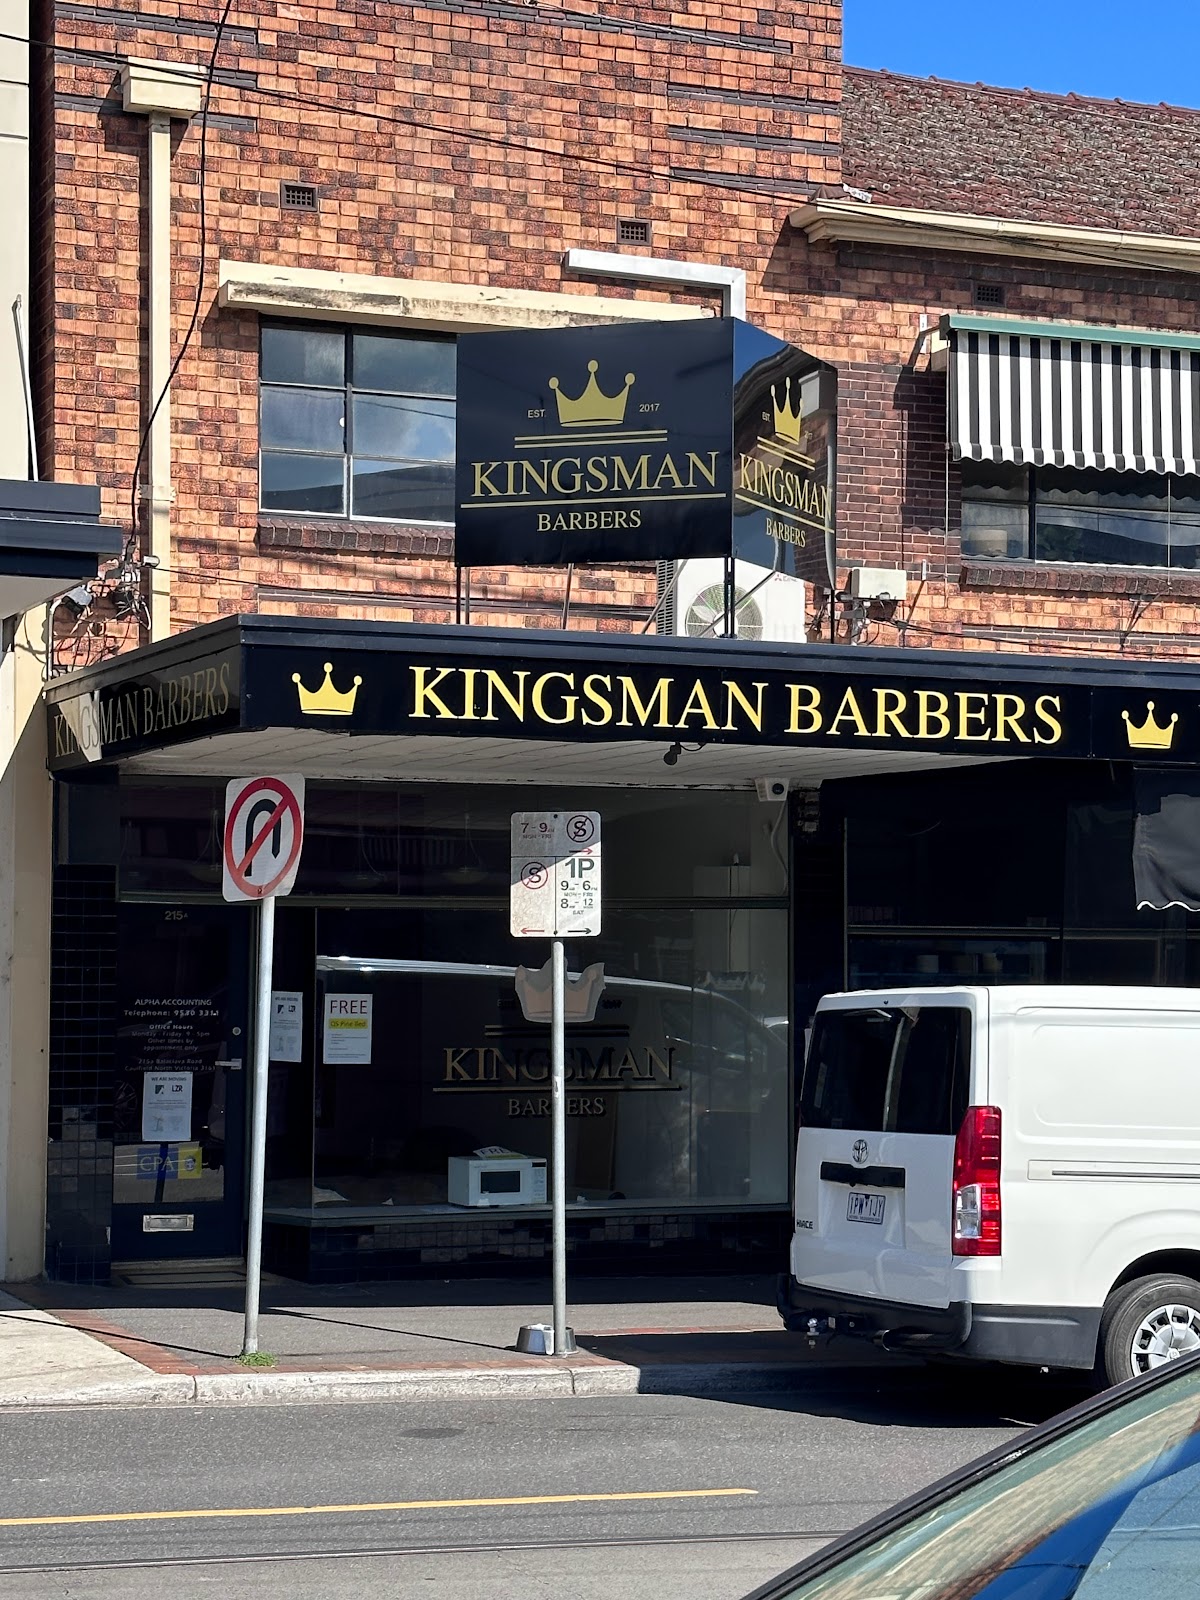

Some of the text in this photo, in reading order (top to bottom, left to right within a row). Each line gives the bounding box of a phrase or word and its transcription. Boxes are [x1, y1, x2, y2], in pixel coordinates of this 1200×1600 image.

[639, 403, 660, 413] 2017
[471, 451, 720, 498] KINGSMAN
[739, 452, 833, 525] KINGSMAN
[537, 509, 642, 532] BARBERS
[765, 516, 806, 548] BARBERS
[53, 662, 231, 758] KINGSMAN BARBERS
[408, 665, 1063, 745] KINGSMAN BARBERS
[564, 857, 595, 879] 1P
[134, 998, 212, 1006] ALPHA ACCOUNTING
[330, 1000, 368, 1014] FREE
[508, 1097, 605, 1116] BARERS
[140, 1156, 174, 1172] CPA
